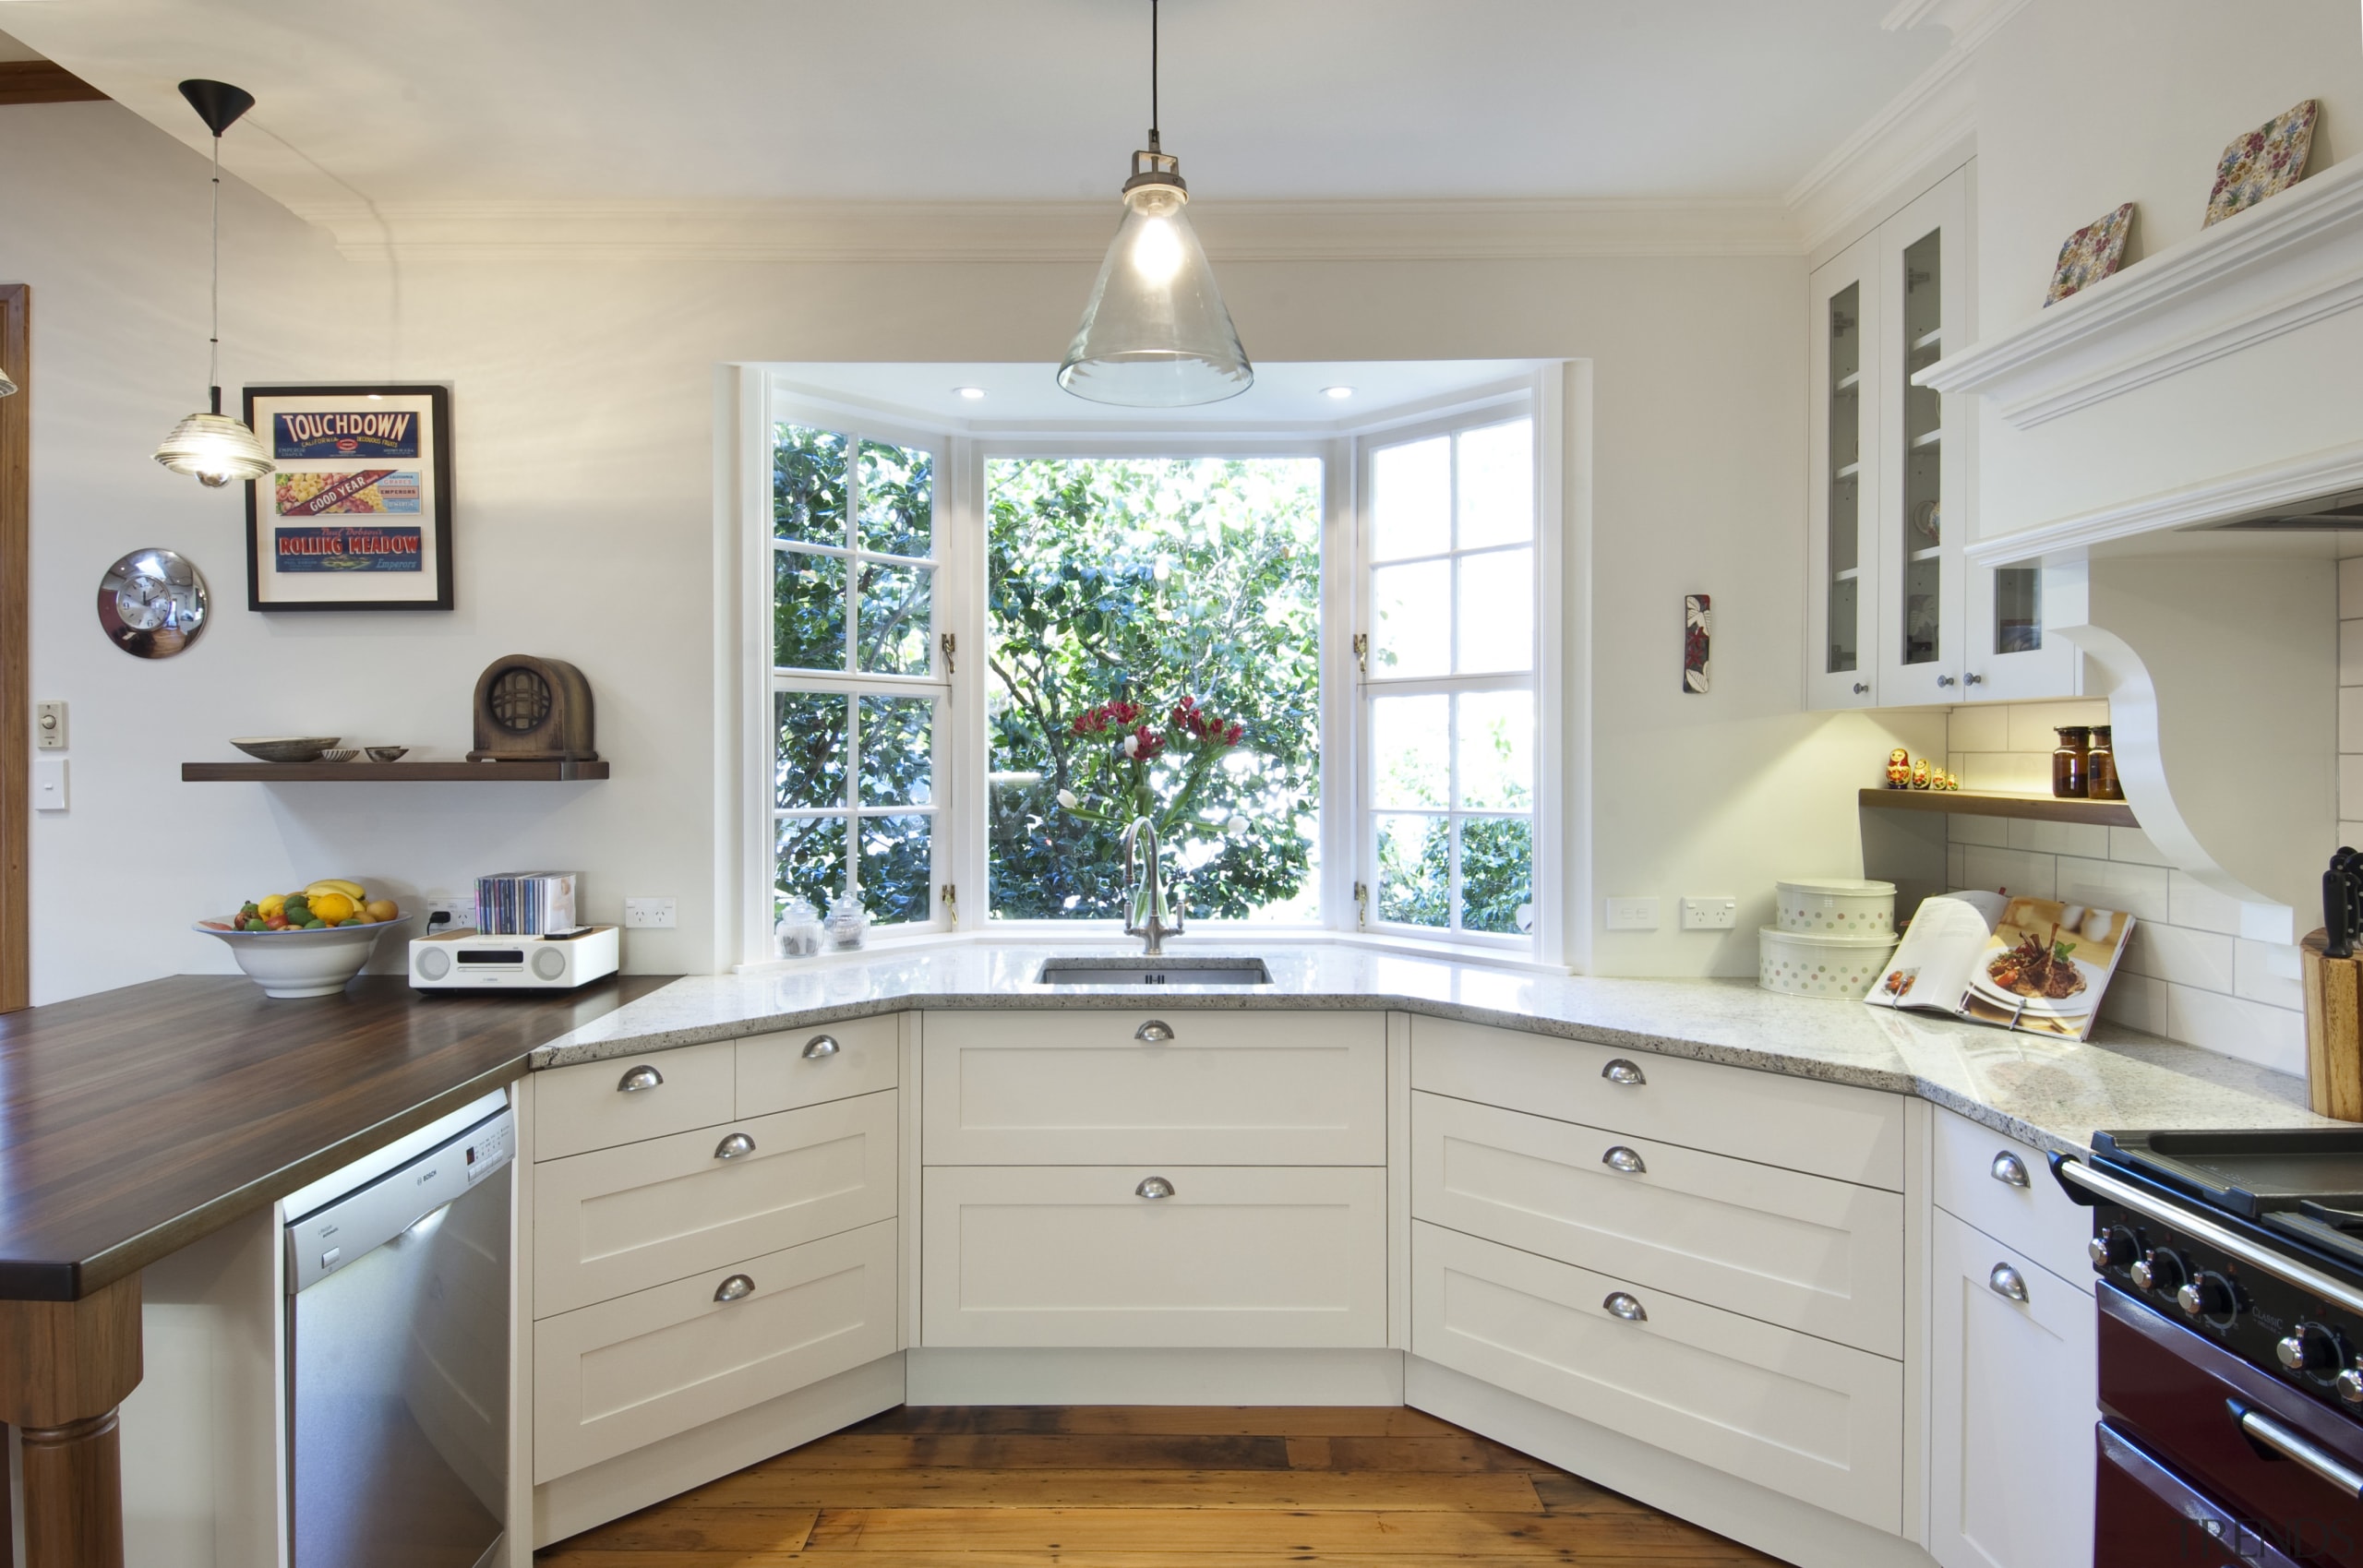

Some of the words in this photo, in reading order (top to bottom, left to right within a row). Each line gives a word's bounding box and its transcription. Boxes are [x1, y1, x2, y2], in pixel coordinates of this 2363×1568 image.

[282, 413, 411, 442] TOUCHDOWN
[301, 437, 340, 448] CALIFORNIA
[309, 492, 338, 513] GOOD
[337, 475, 366, 497] YEAR
[279, 536, 343, 556] ROLLING
[348, 534, 419, 555] MEADOW
[376, 557, 417, 570] Emperors
